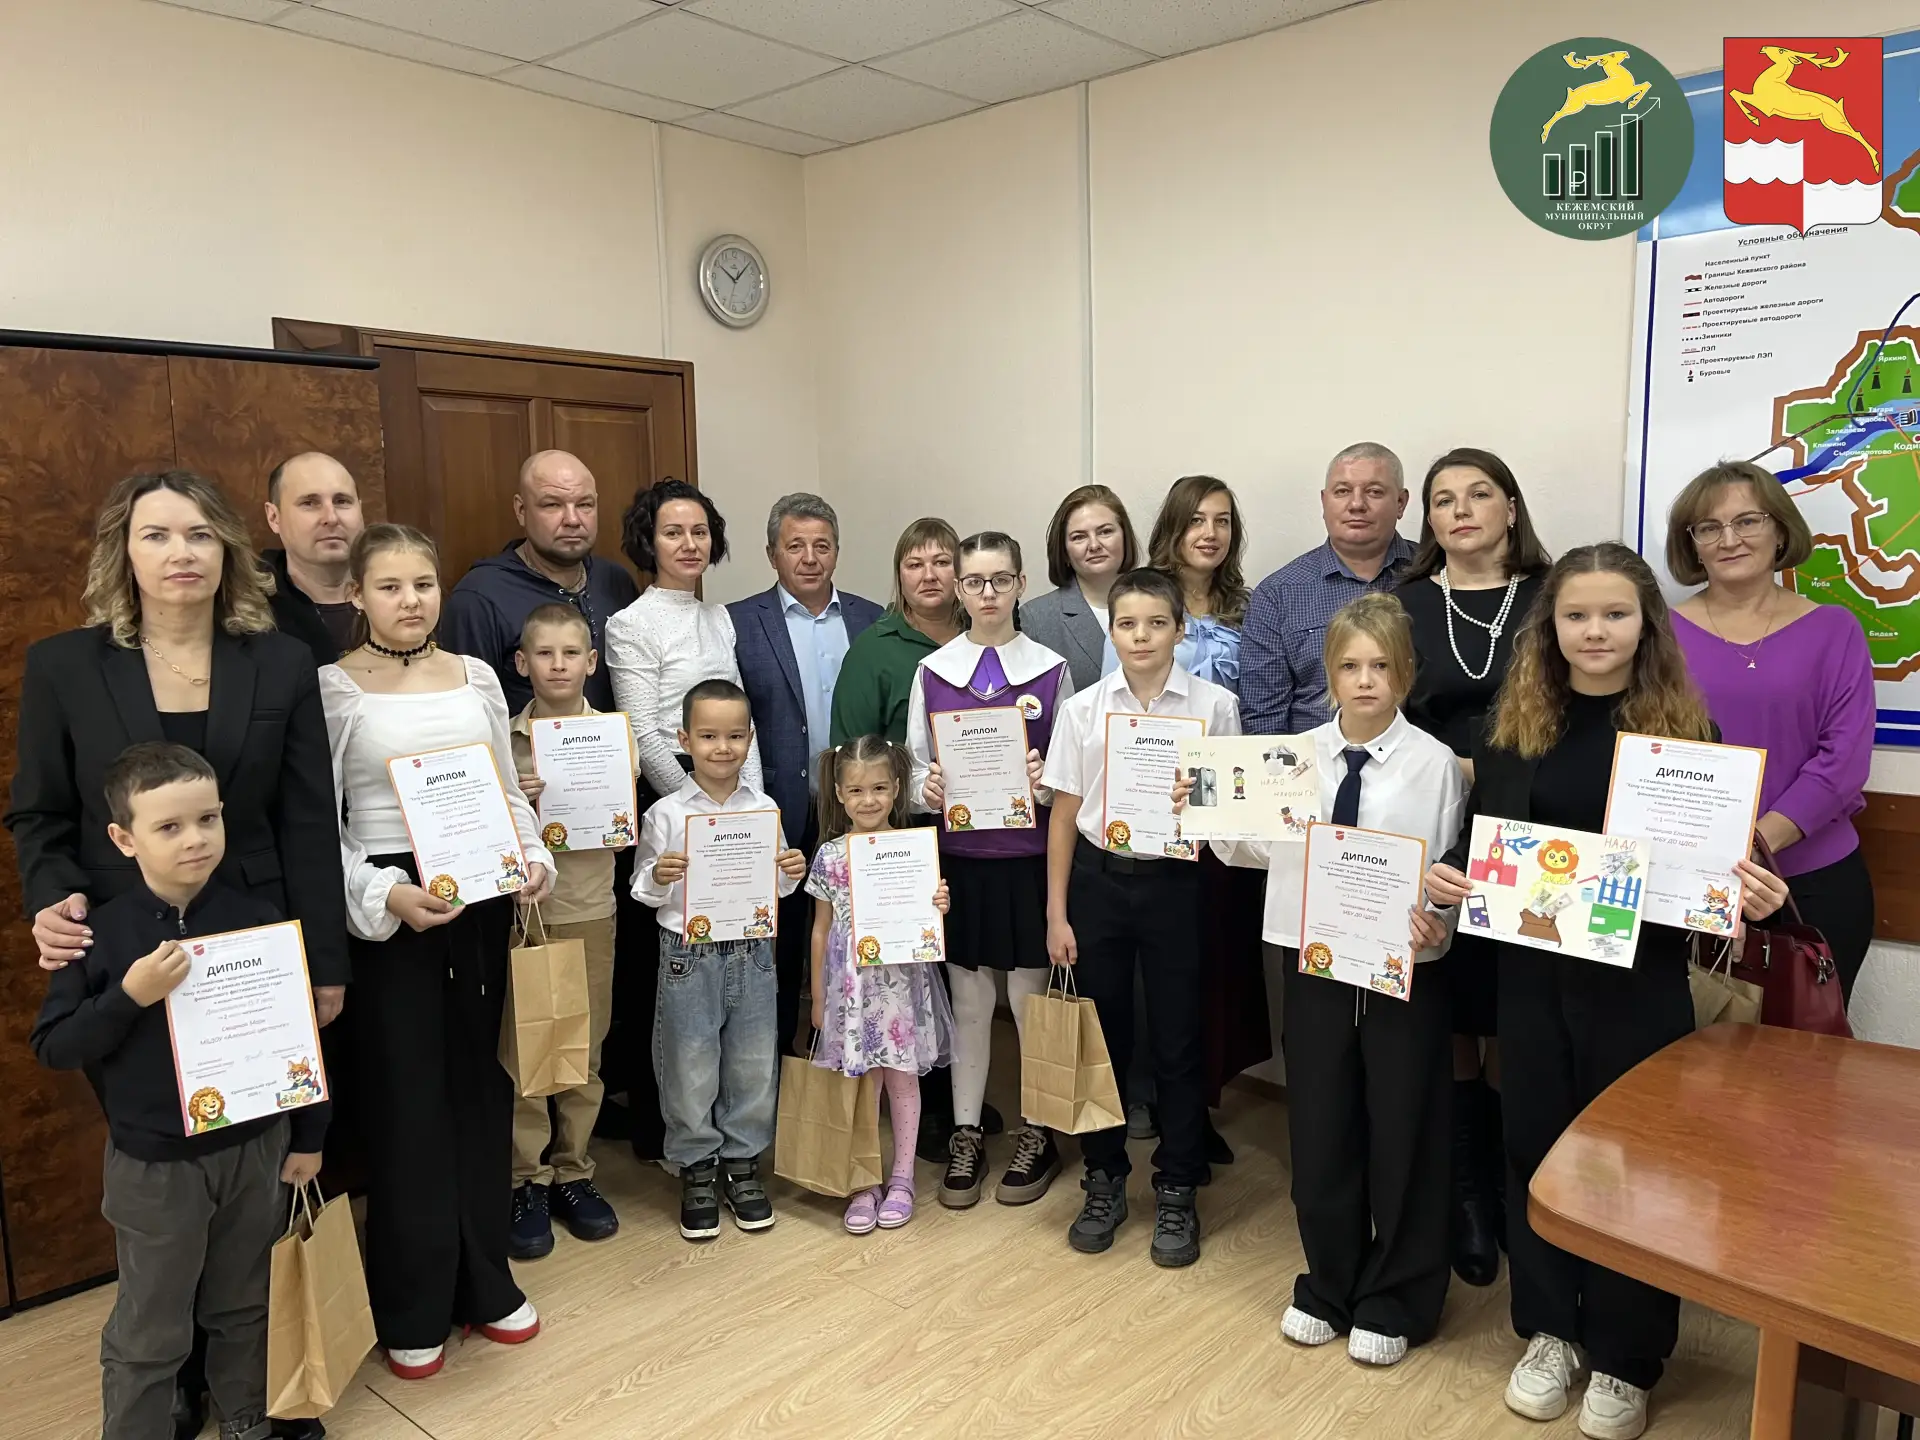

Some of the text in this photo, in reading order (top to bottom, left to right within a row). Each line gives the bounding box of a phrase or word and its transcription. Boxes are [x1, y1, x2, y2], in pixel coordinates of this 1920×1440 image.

[1738, 234, 1784, 247] Условные
[1705, 253, 1771, 267] Населенный пункт
[1704, 262, 1806, 280] Границы Кежемского района
[1704, 279, 1767, 291] Железные дороги
[1703, 294, 1745, 304] Автодороги
[1702, 298, 1823, 316] Проектируемые железные дороги
[1702, 312, 1802, 328] Проектируемые автодороги
[1701, 332, 1732, 340] Зимники
[1699, 354, 1755, 365] Проектируемые
[1878, 355, 1907, 363] Яркино
[1699, 368, 1731, 377] Буровые
[1893, 442, 1920, 451] Коди
[1810, 580, 1831, 589] Ирба
[961, 727, 998, 737] ДИПЛОМ
[562, 735, 601, 746] ДИПЛОМ
[1135, 737, 1174, 746] ДИПЛОМ
[426, 770, 466, 786] ДИПЛОМ
[1656, 767, 1714, 783] ДИПЛОМ
[1504, 821, 1533, 834] ХОЧУ
[714, 832, 751, 842] ДИПЛОМ
[1604, 837, 1637, 851] НАДО
[875, 851, 911, 860] ДИПЛОМ
[1341, 851, 1388, 867] ДИПЛОМ
[206, 957, 262, 978] ДИПЛОМ
